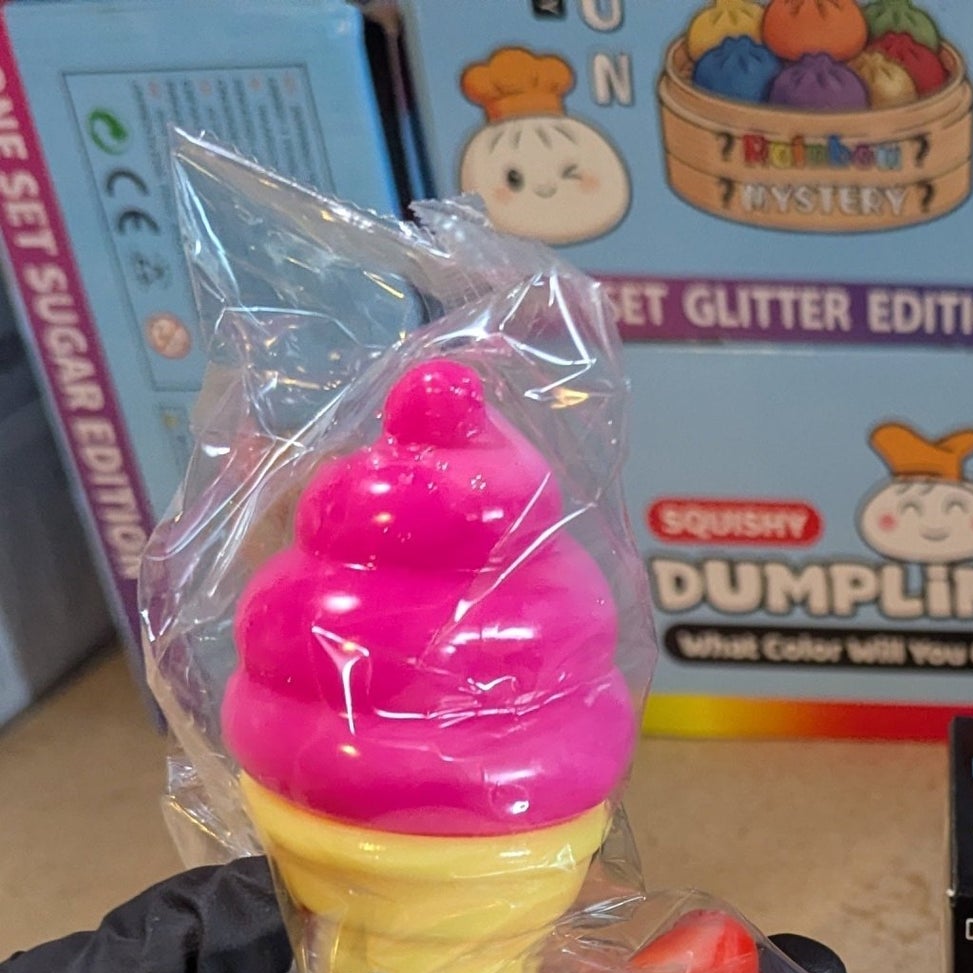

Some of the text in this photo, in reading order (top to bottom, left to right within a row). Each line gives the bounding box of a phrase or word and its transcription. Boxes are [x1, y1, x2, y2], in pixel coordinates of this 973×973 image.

[0, 170, 59, 257] SET
[741, 183, 909, 215] MYSTERY
[683, 284, 851, 331] GLITTER
[22, 261, 106, 412] SUGAR
[661, 506, 808, 540] SQUISHY
[676, 631, 760, 660] What
[762, 634, 842, 664] Color
[846, 636, 906, 666] Will
[908, 640, 967, 668] You
